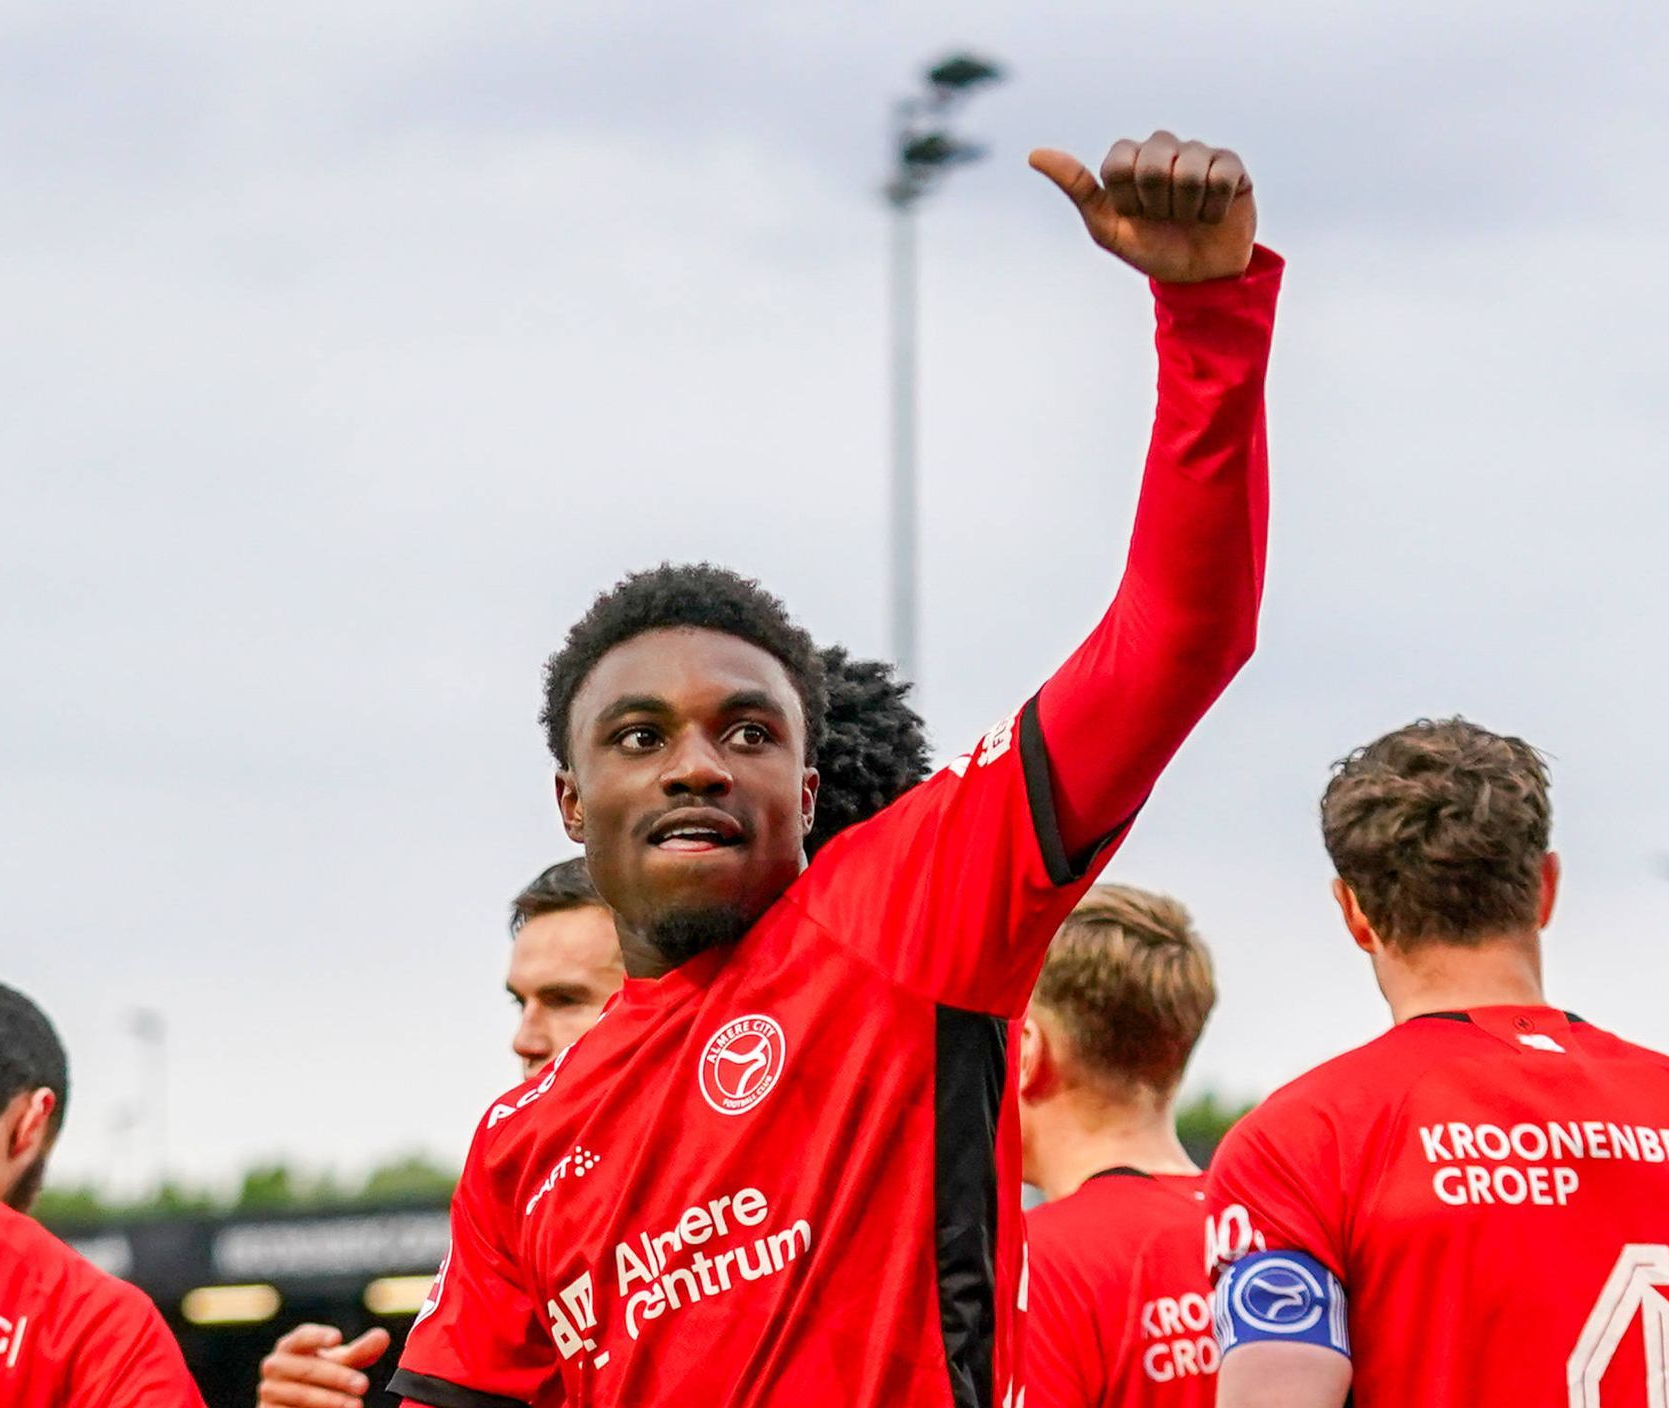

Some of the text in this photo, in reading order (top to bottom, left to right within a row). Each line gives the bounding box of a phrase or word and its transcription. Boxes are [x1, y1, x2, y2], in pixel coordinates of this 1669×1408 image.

[706, 1020, 777, 1065] ALMERE CITY
[1433, 1166, 1580, 1206] GROEP
[1141, 1291, 1217, 1340] KRO
